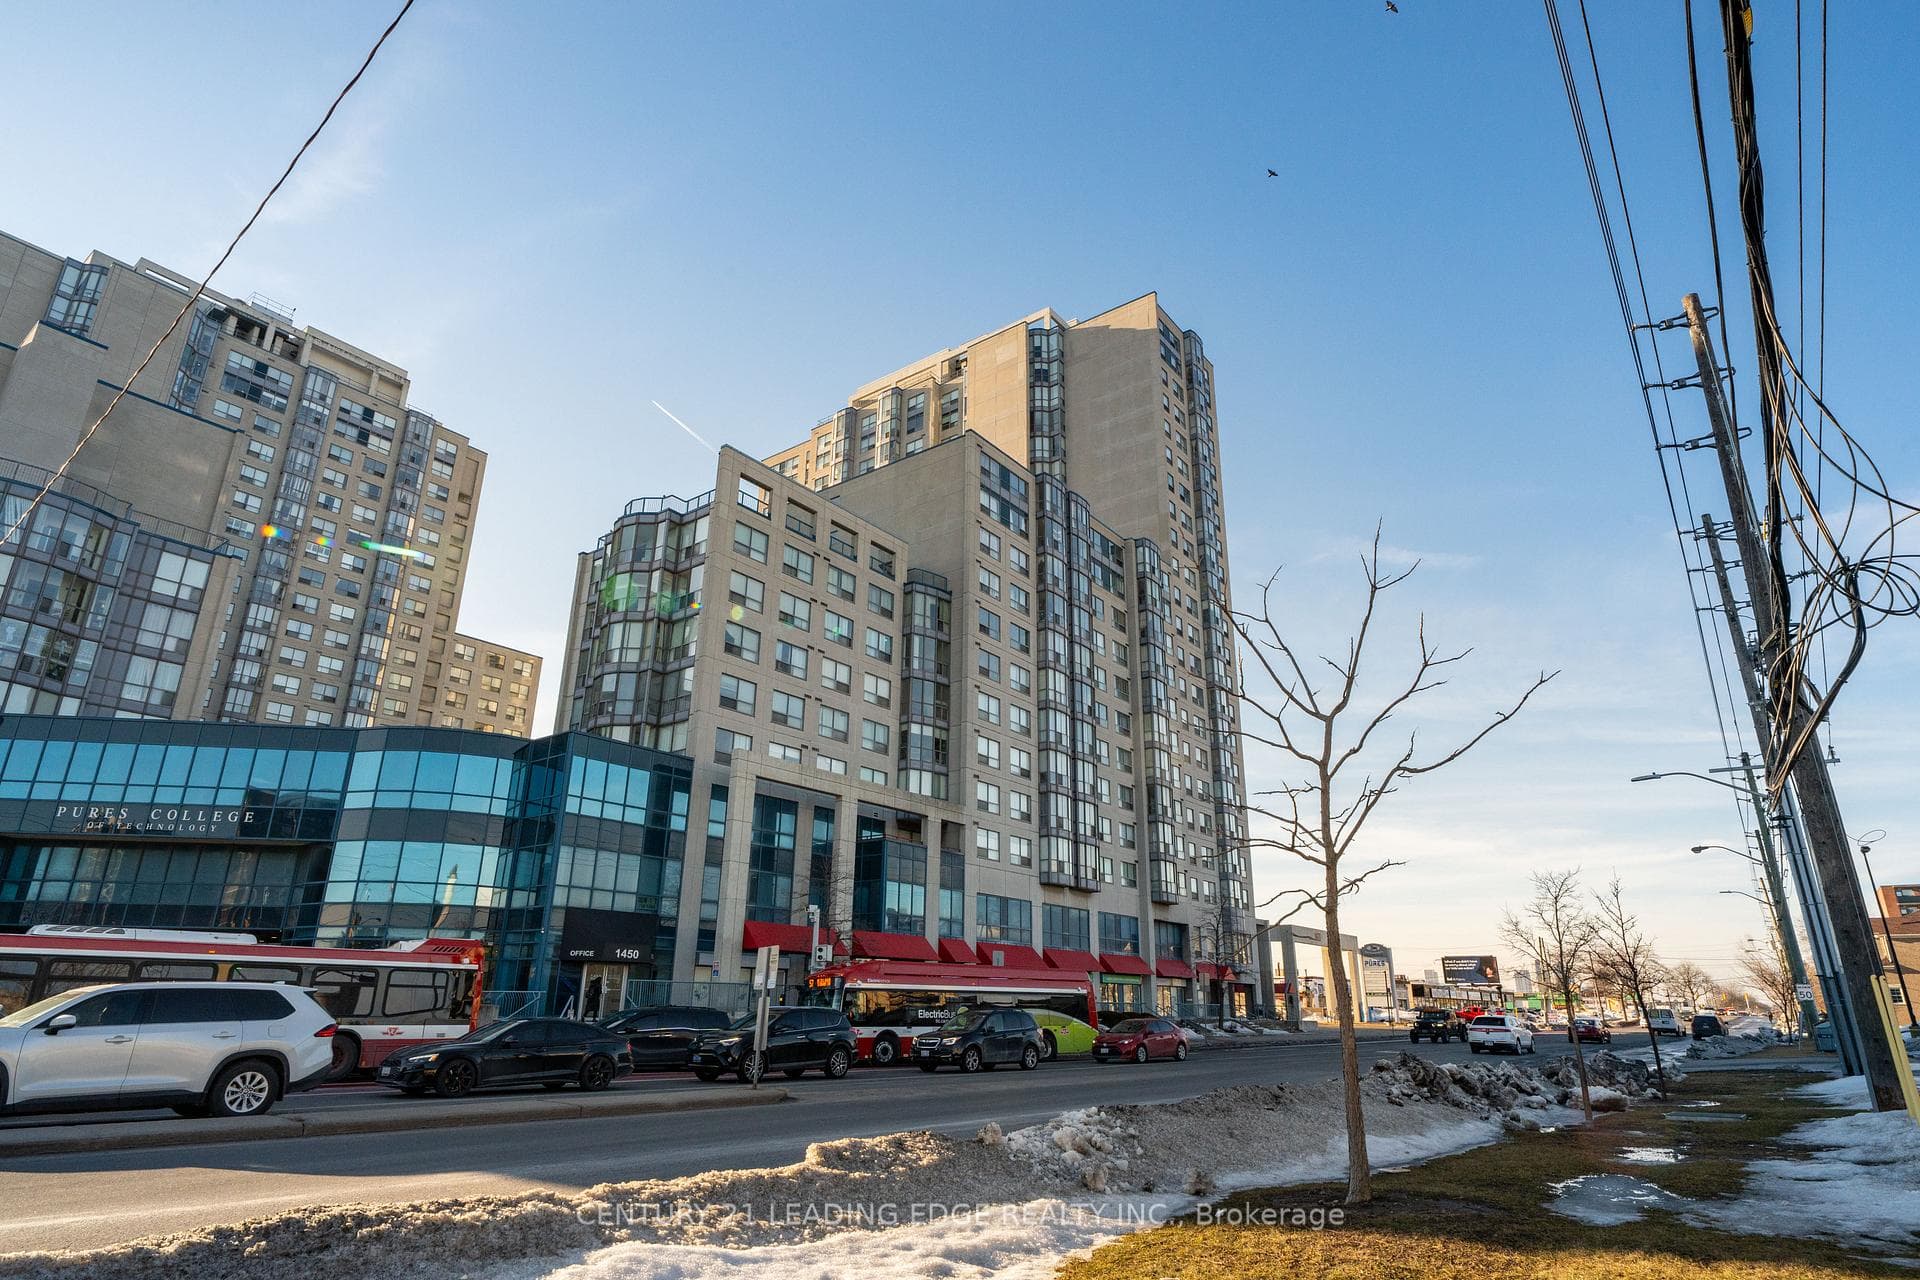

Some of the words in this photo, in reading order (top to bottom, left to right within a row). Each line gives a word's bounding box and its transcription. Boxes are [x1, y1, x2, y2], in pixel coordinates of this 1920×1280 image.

[56, 806, 129, 820] PURES
[150, 808, 255, 824] COLLEGE
[116, 822, 218, 833] TECHNOLOGY
[616, 949, 639, 959] 1450
[1799, 991, 1813, 999] 50
